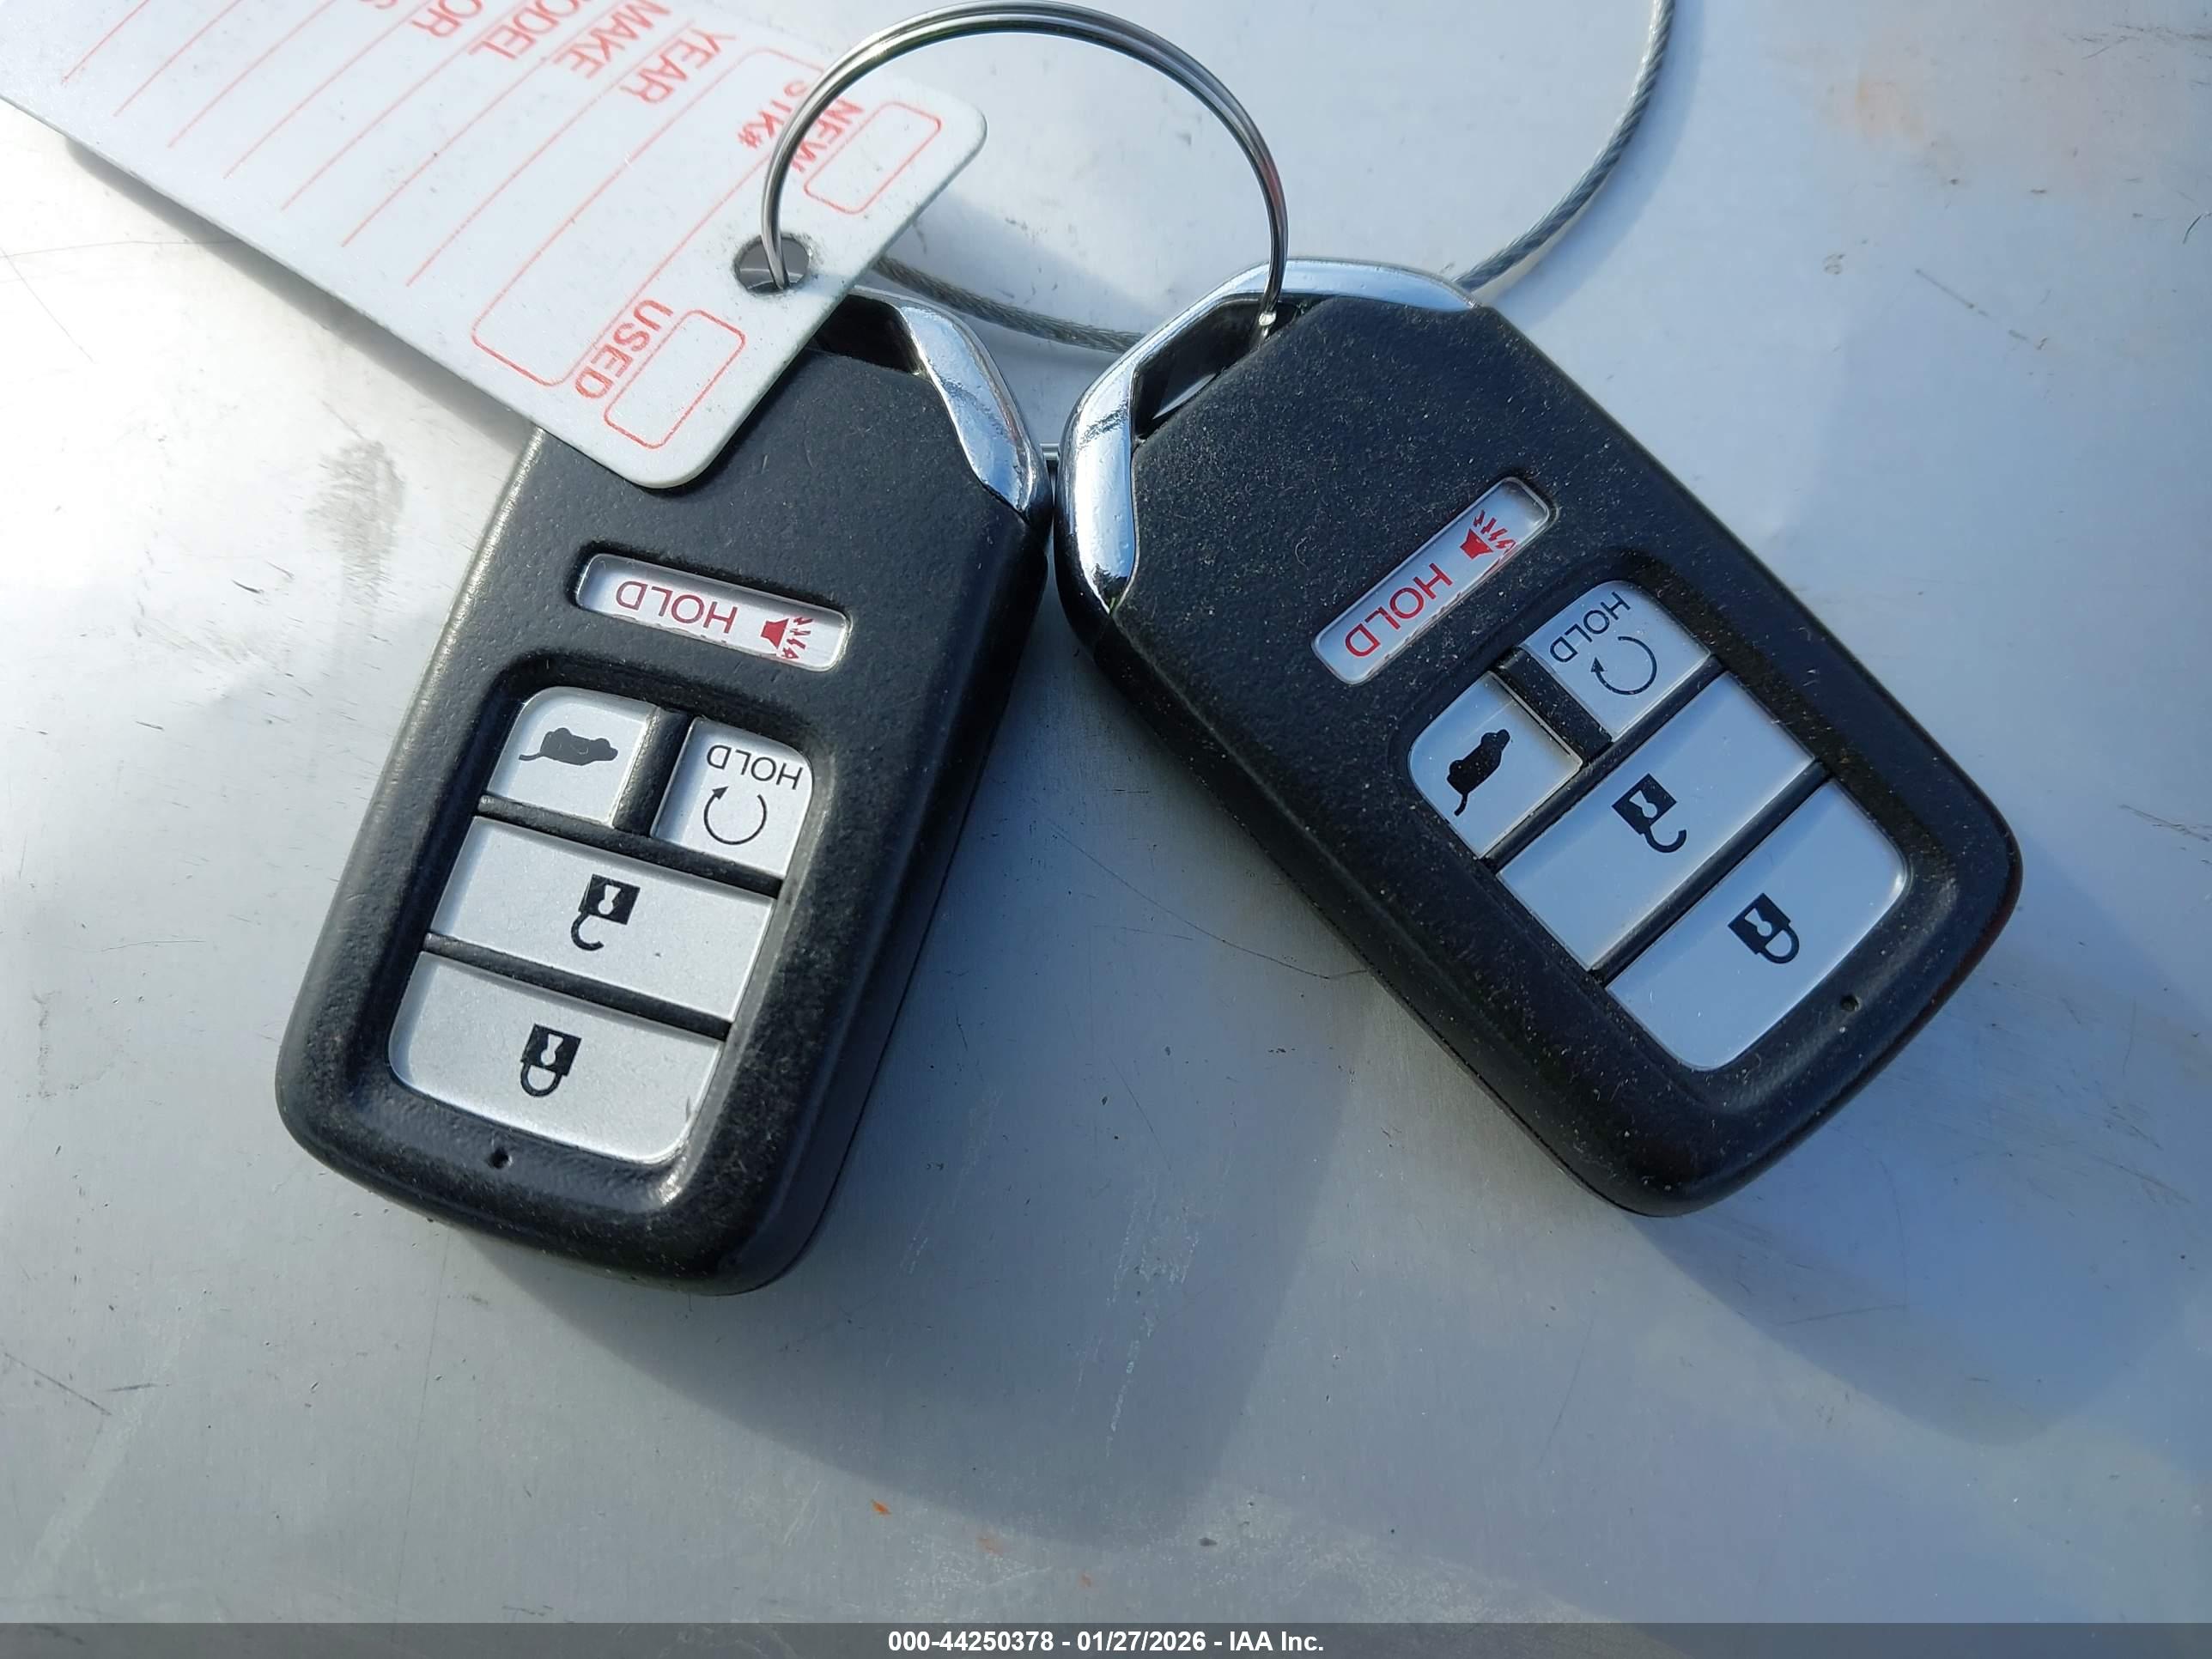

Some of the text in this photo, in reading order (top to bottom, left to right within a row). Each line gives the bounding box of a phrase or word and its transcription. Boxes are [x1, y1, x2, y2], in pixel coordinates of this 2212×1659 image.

[468, 0, 580, 60] ODEL
[552, 0, 672, 79] MAKE
[618, 27, 737, 104] YEAR
[574, 299, 674, 399] USED
[615, 580, 738, 635] HOLD
[1344, 562, 1454, 658] HOLD
[1549, 591, 1632, 664] HOLD
[706, 744, 805, 791] HOLD
